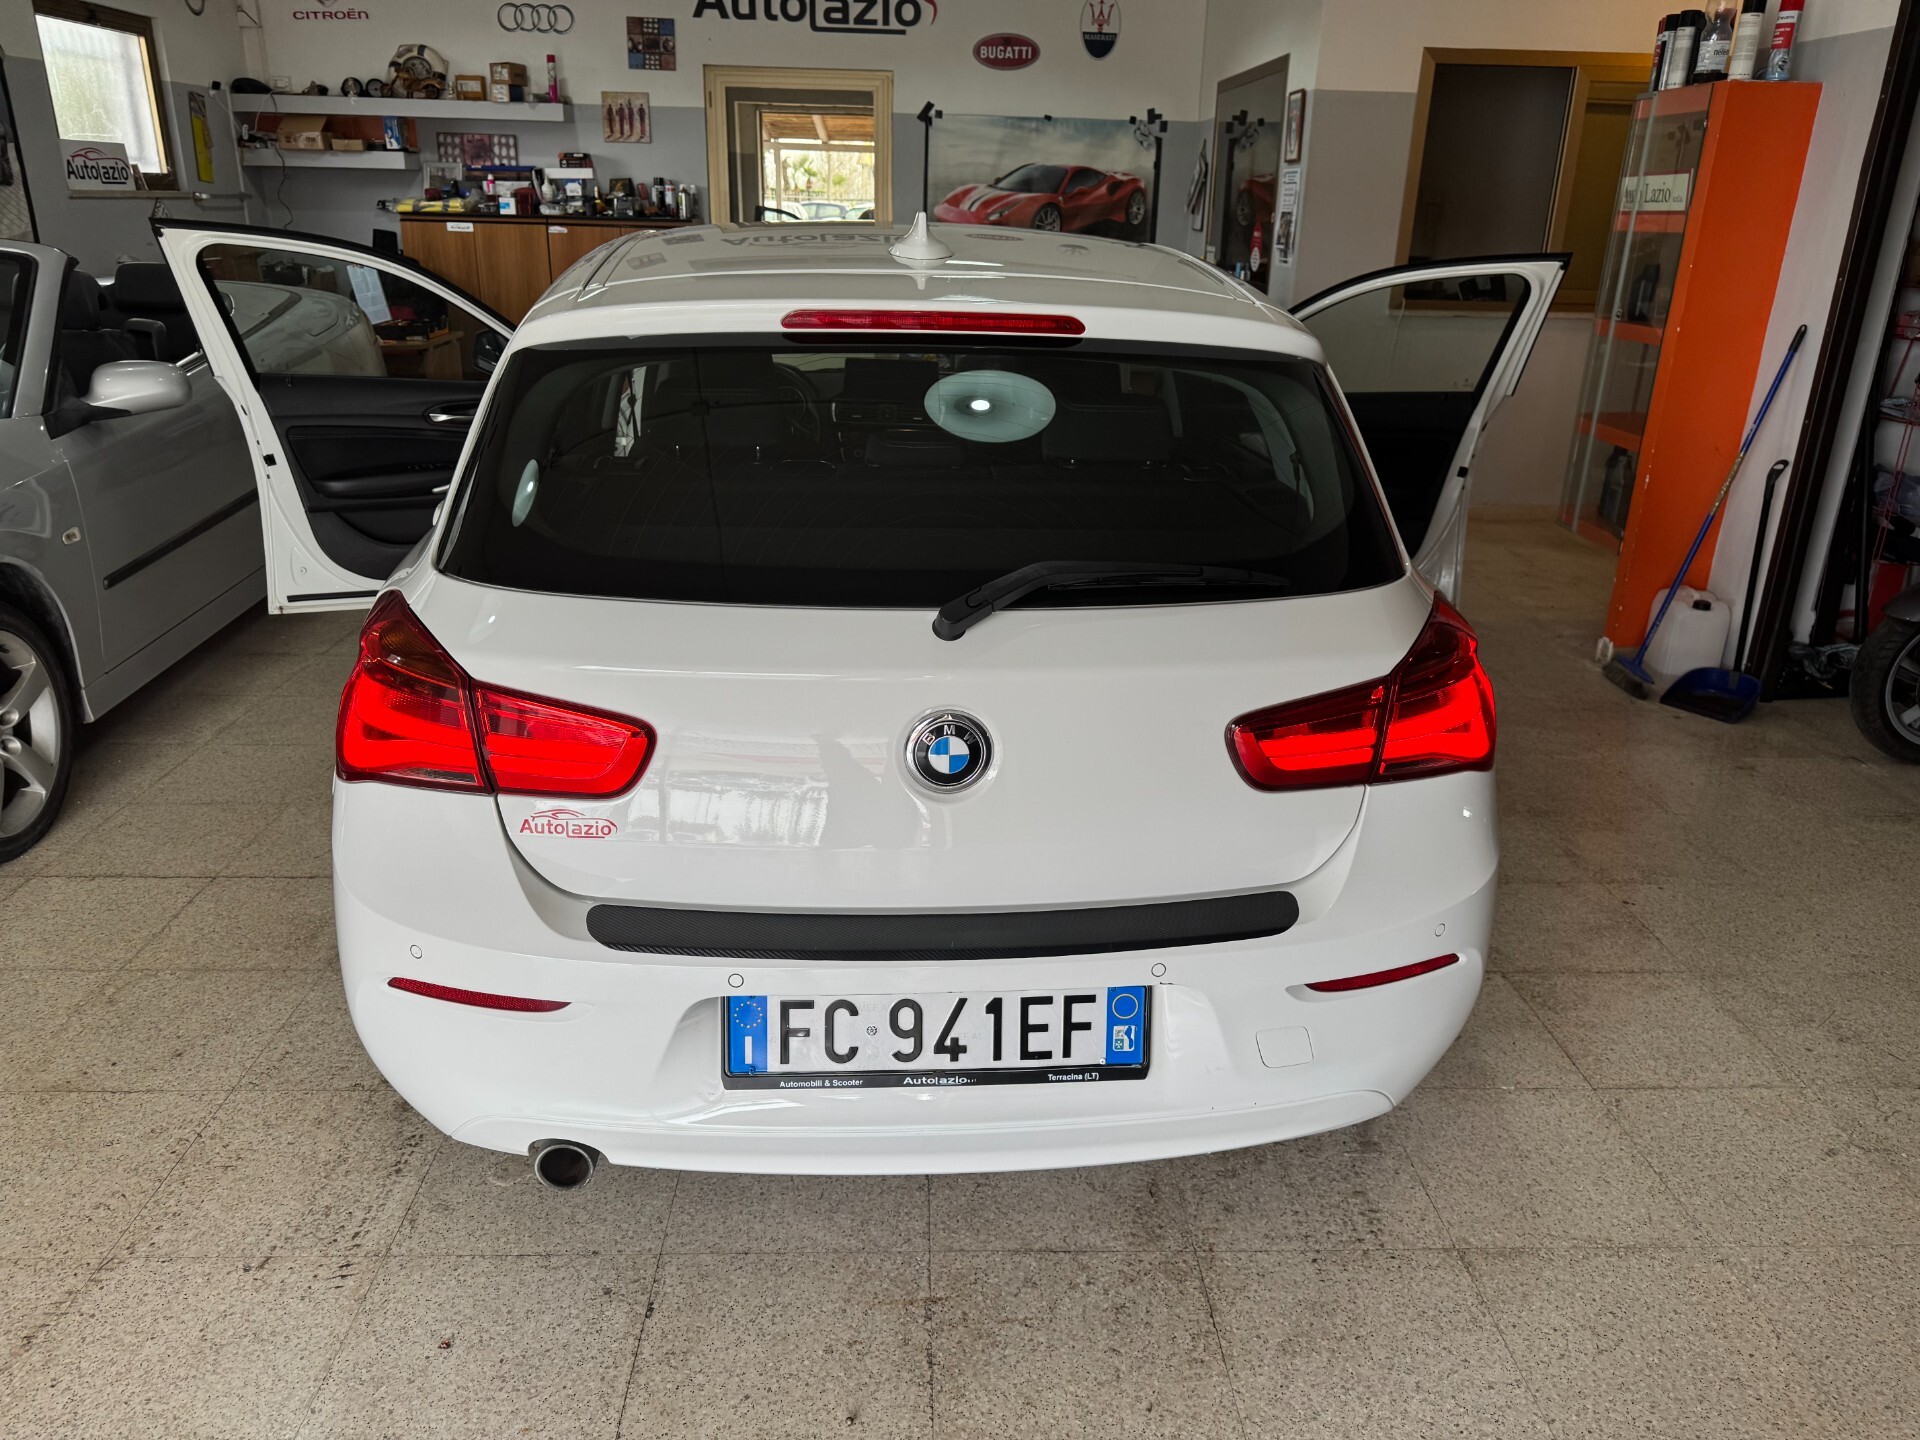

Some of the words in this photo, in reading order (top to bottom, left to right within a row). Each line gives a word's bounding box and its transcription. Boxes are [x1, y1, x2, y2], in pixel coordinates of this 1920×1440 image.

[1085, 33, 1117, 41] MASERATI
[980, 46, 1032, 59] BUGATTI
[1644, 182, 1671, 203] Lazio
[922, 724, 977, 746] BMW
[779, 999, 859, 1065] FC
[889, 994, 1097, 1064] 941EF
[744, 1035, 753, 1065] I
[779, 1080, 823, 1089] Automobili
[824, 1079, 831, 1088] &
[832, 1078, 864, 1087] Scooter
[1047, 1073, 1083, 1082] Terracina
[1083, 1071, 1100, 1082] (LT)
